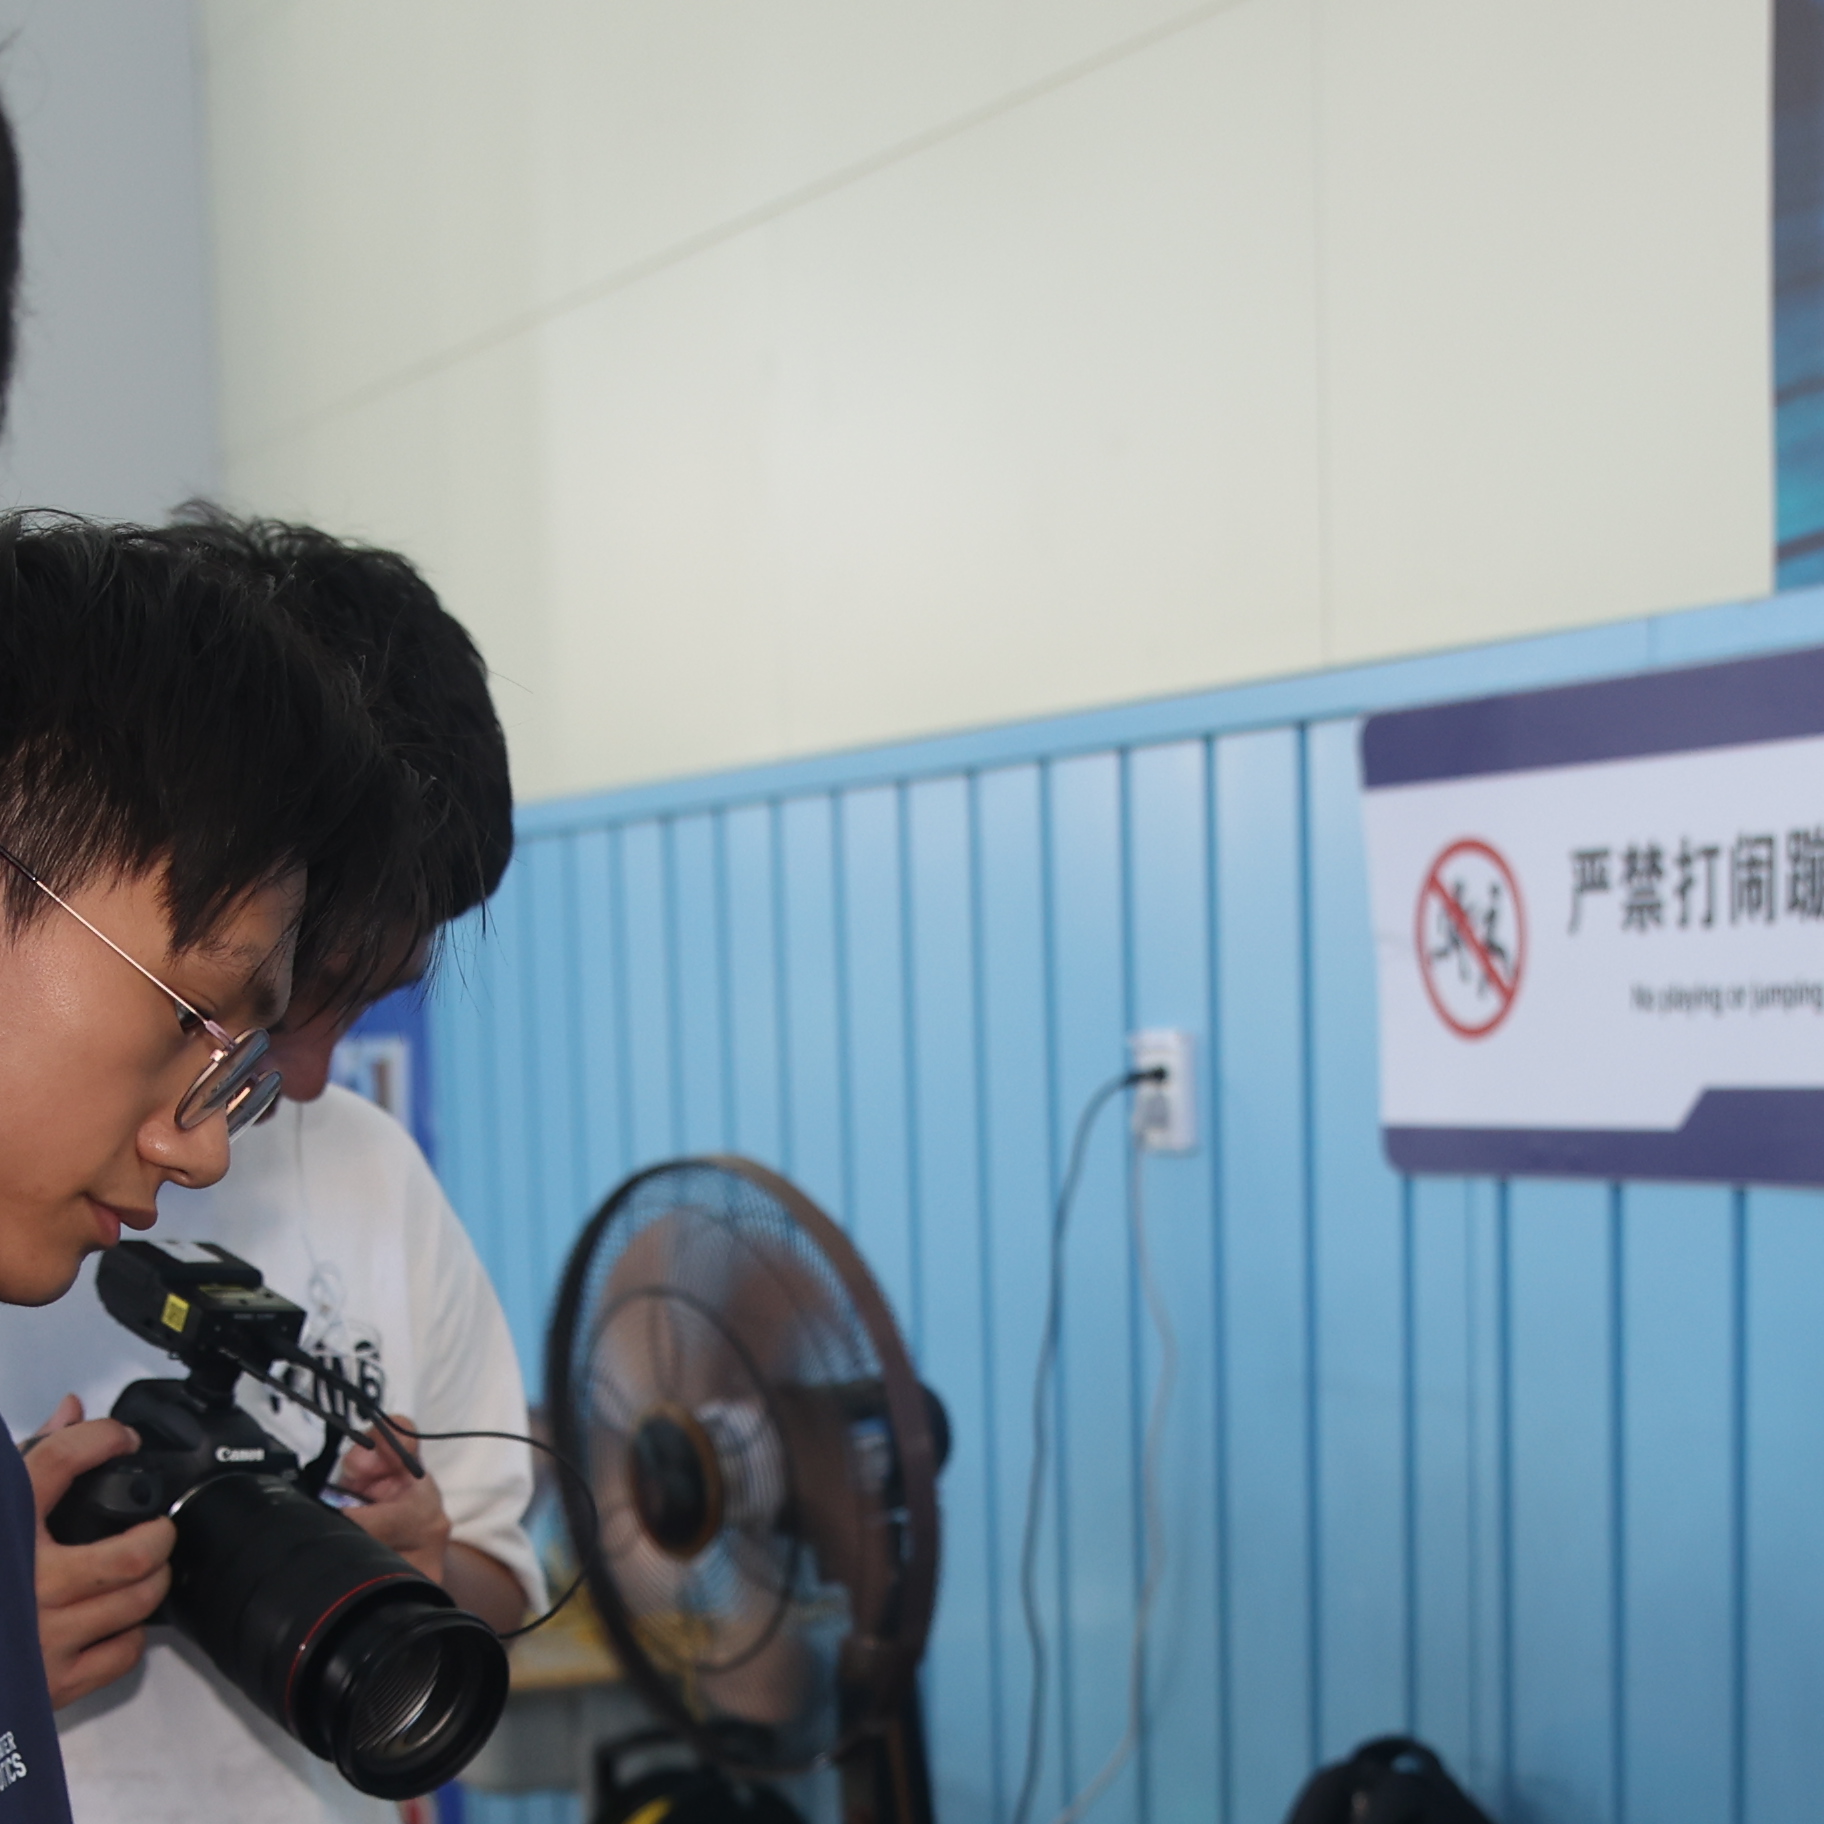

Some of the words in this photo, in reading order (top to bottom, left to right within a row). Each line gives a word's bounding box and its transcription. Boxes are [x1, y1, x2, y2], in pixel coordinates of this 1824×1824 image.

[1630, 981, 1654, 1012] No
[1657, 982, 1724, 1019] playing
[1728, 985, 1747, 1010] or
[215, 1446, 266, 1463] Canon
